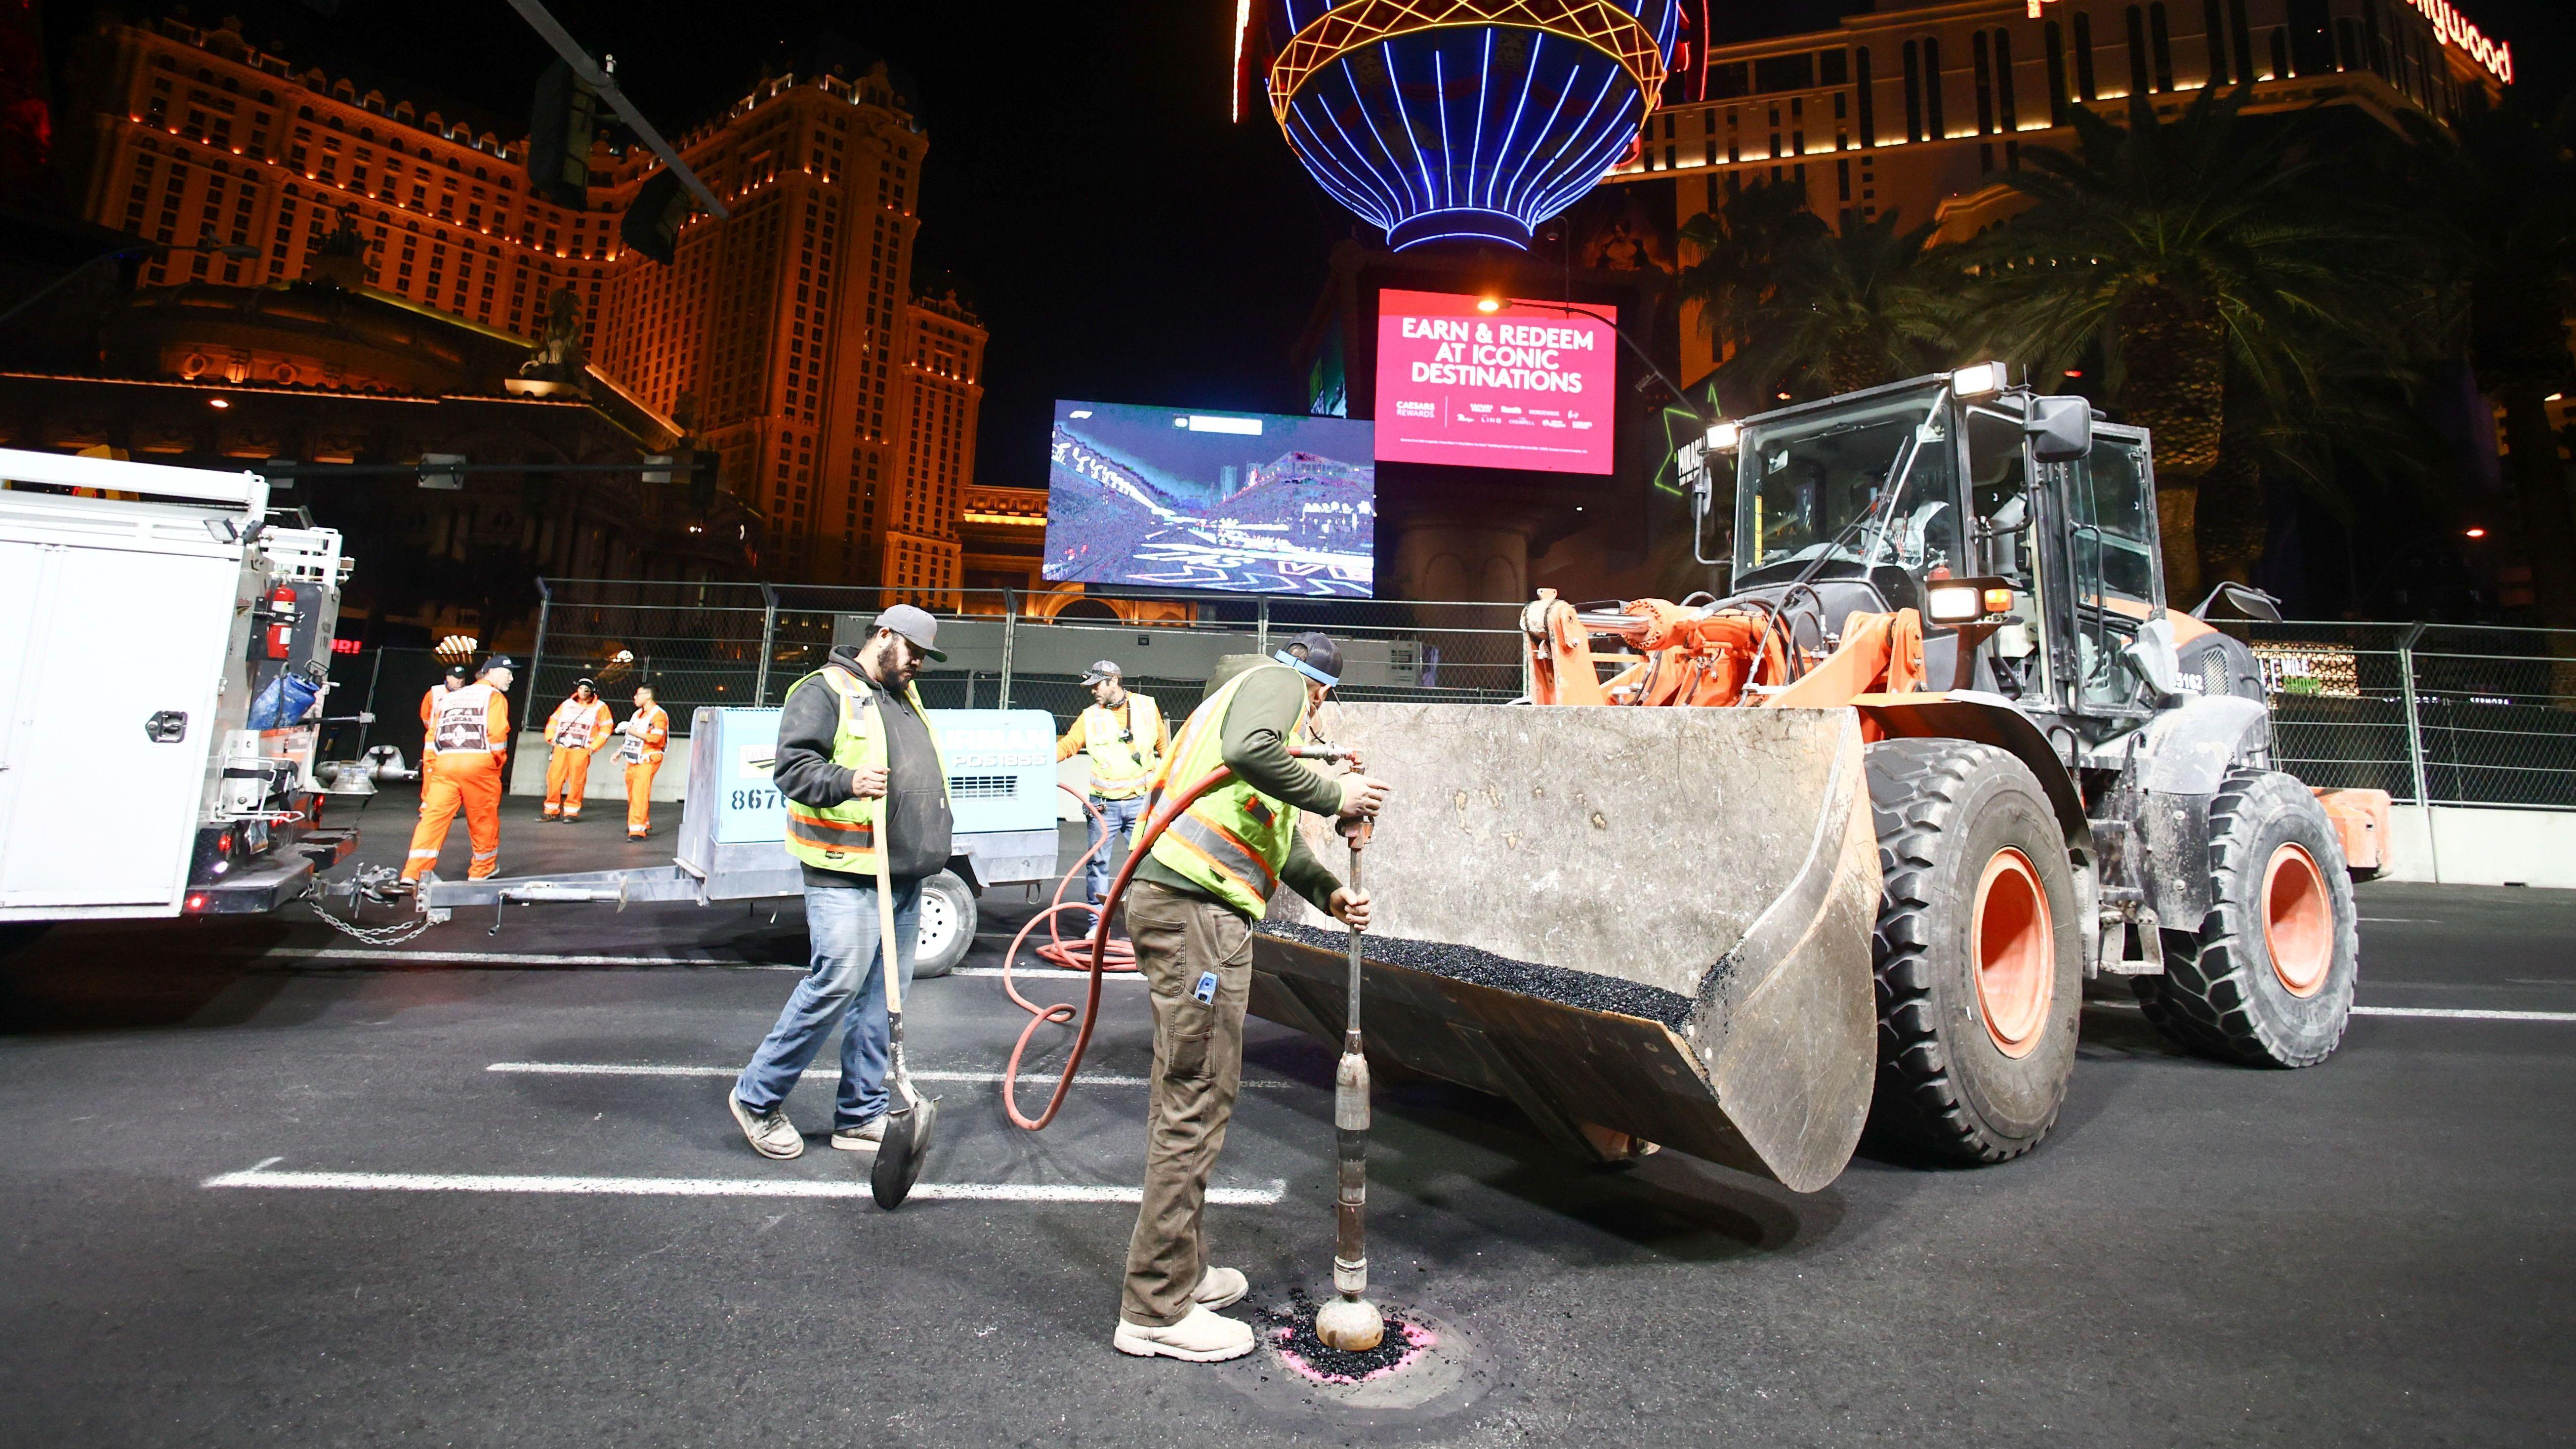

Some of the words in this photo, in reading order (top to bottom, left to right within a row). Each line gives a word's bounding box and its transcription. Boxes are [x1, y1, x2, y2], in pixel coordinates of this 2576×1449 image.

[2407, 0, 2512, 84] ywood
[1402, 317, 1468, 341] EARN
[1475, 323, 1493, 344] &
[1499, 325, 1593, 351] REDEEM
[1435, 342, 1466, 363] AT
[1472, 344, 1559, 370] ICONIC
[1412, 362, 1582, 393] DESTINATIONS
[1396, 401, 1435, 411] CAESARS
[1396, 409, 1435, 418] REWARDS
[1678, 435, 1705, 477] MIRAC
[2174, 672, 2203, 691] 5162
[2281, 659, 2312, 677] MILE
